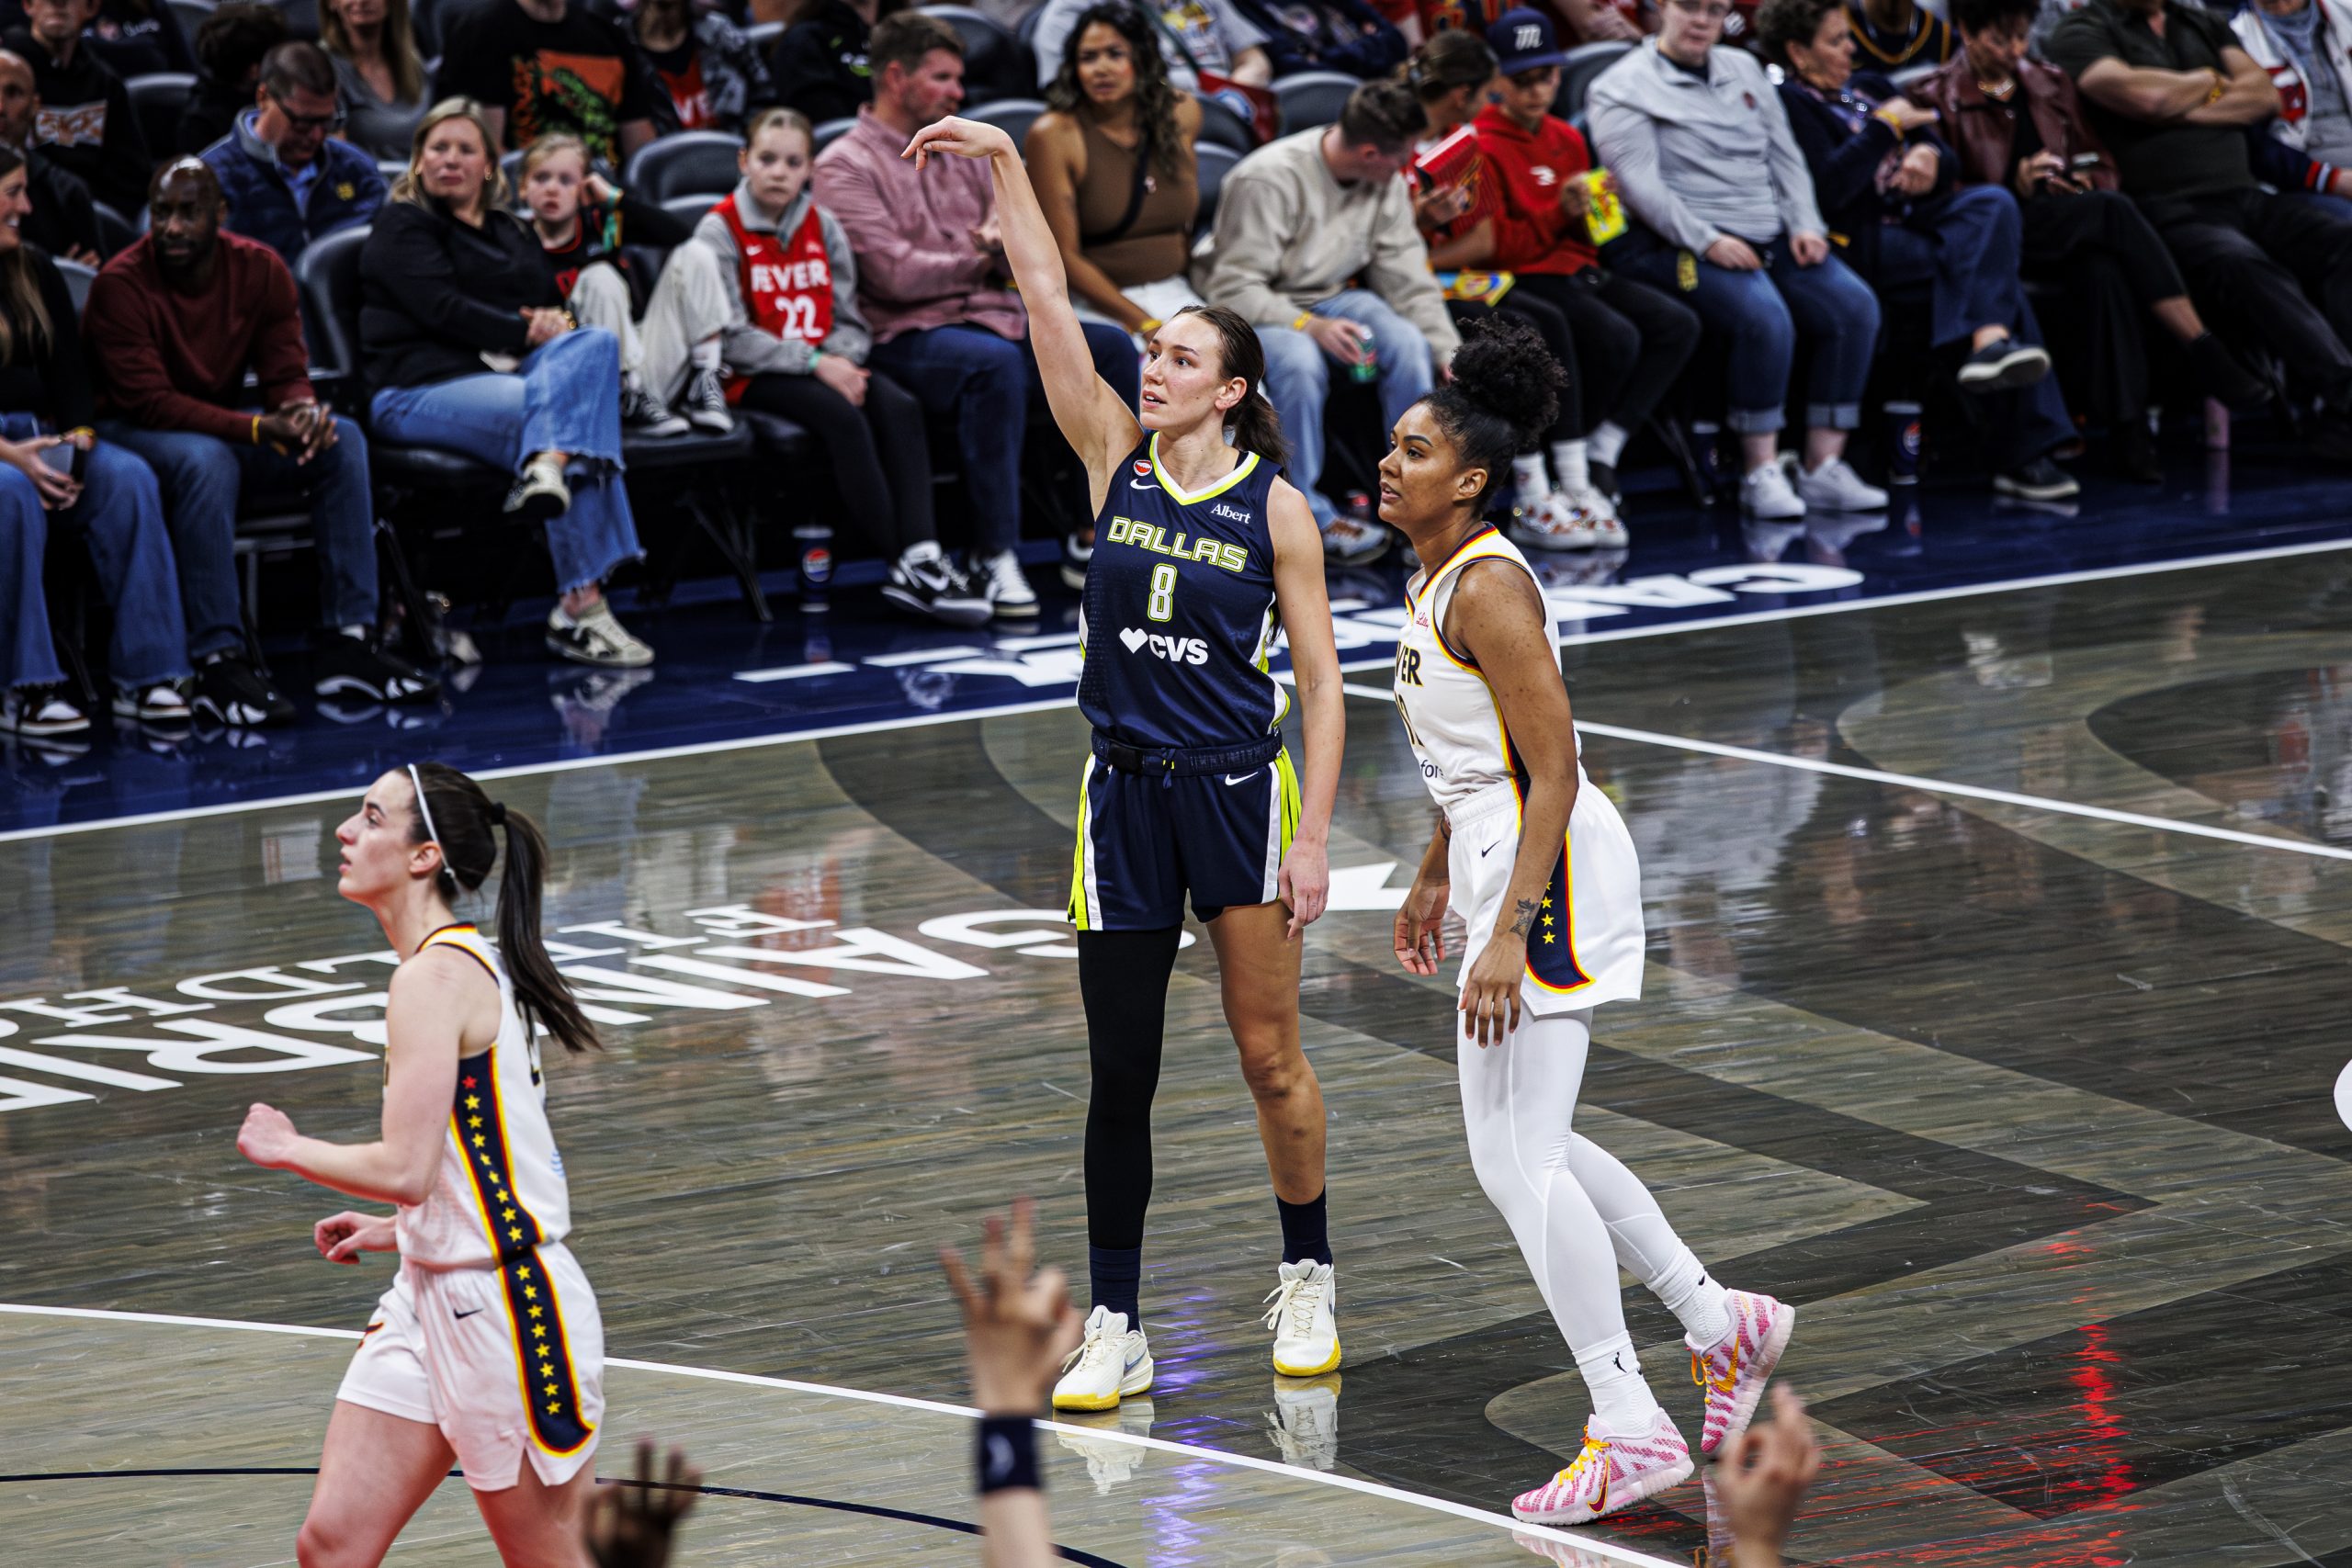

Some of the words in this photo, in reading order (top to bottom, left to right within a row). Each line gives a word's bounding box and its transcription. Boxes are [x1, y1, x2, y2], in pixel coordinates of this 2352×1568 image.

[775, 295, 824, 340] 22
[1211, 503, 1251, 525] Albert
[1107, 515, 1249, 573] DALLAS
[1148, 562, 1178, 623] 8
[1149, 634, 1209, 665] CVS
[1396, 640, 1424, 687] VER
